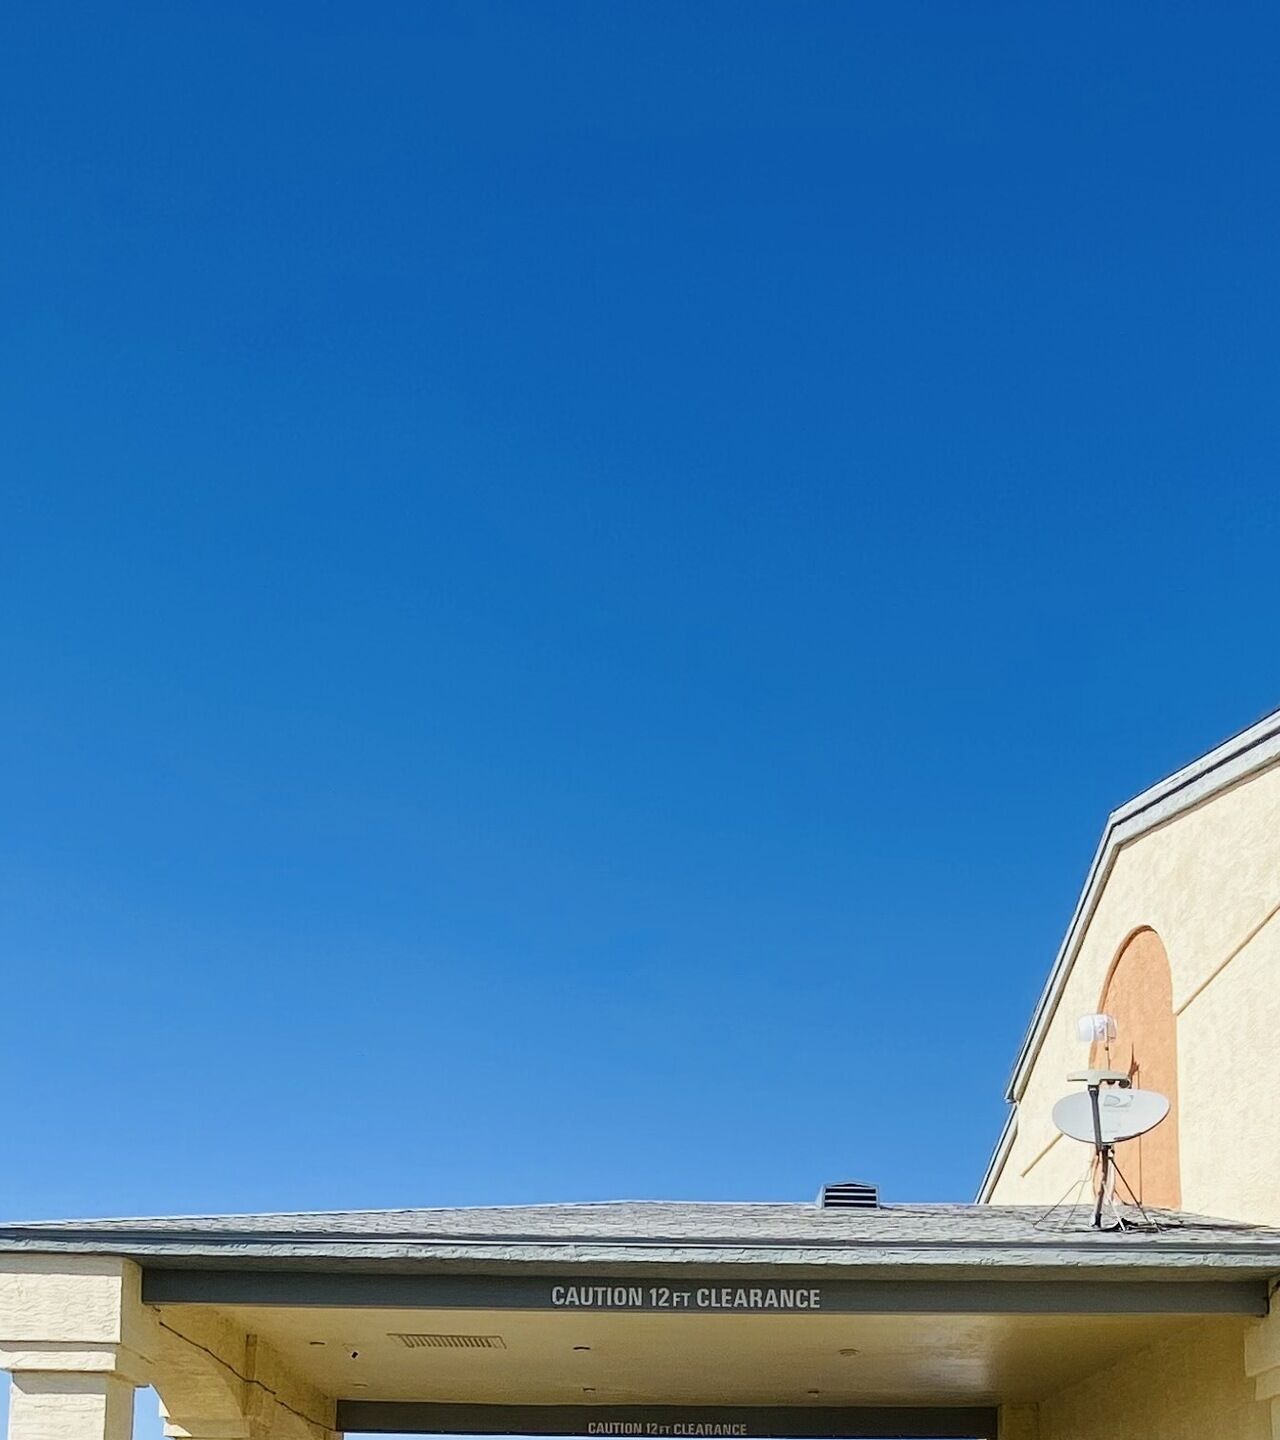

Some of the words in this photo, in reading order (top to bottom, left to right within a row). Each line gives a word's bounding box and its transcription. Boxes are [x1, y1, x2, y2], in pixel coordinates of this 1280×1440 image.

[551, 1286, 643, 1306] CAUTION
[696, 1288, 821, 1309] CLEARANCE
[588, 1422, 642, 1435] CAUTION
[673, 1423, 747, 1436] CLEARANCE
